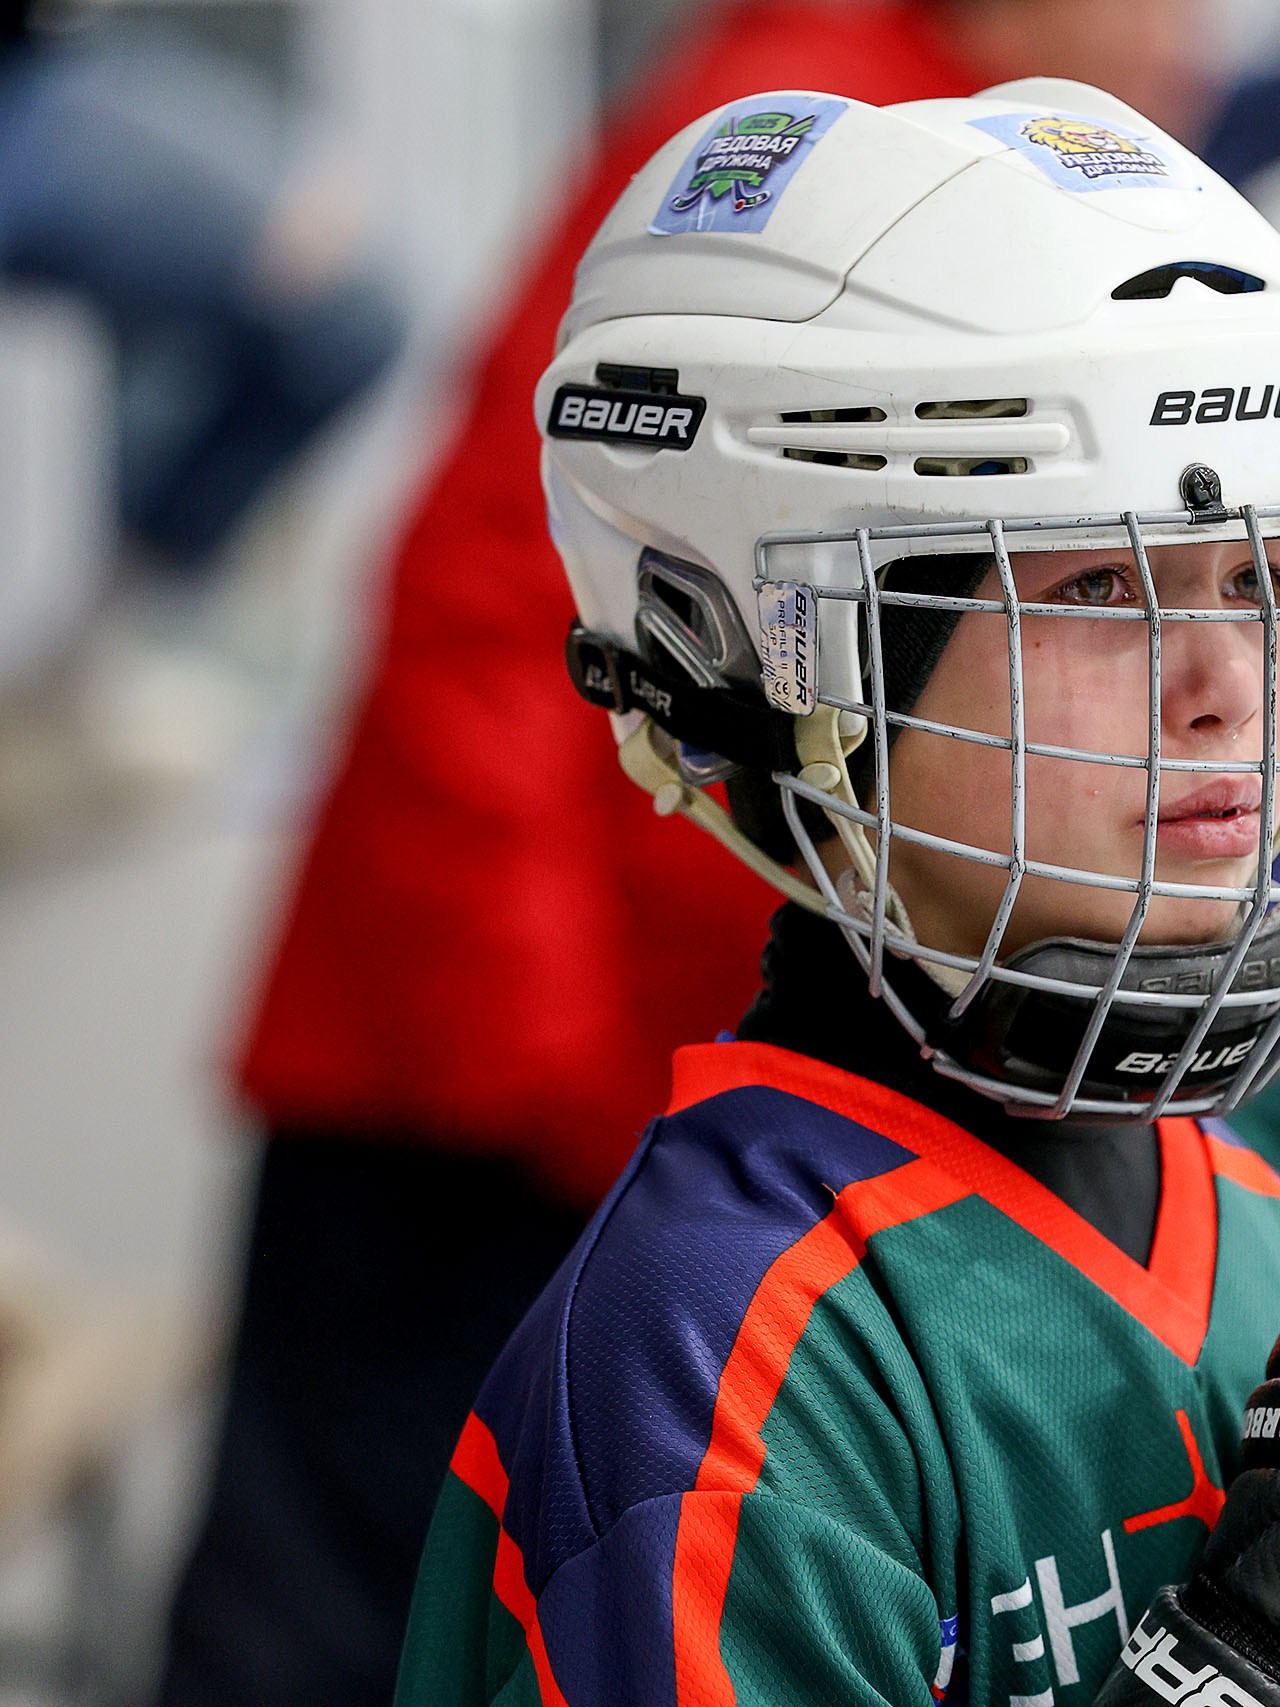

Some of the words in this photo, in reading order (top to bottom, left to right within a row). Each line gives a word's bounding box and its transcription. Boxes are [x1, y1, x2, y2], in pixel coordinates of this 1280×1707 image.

[701, 134, 800, 156] ЛЕДОВАЯ
[1062, 152, 1158, 167] ЛЕДОВАЯ
[697, 154, 773, 174] ДРУЖИНА
[558, 396, 693, 438] BAUER
[777, 600, 788, 658] PROFILE
[795, 589, 807, 705] BAUER
[1115, 1037, 1258, 1073] BAUE
